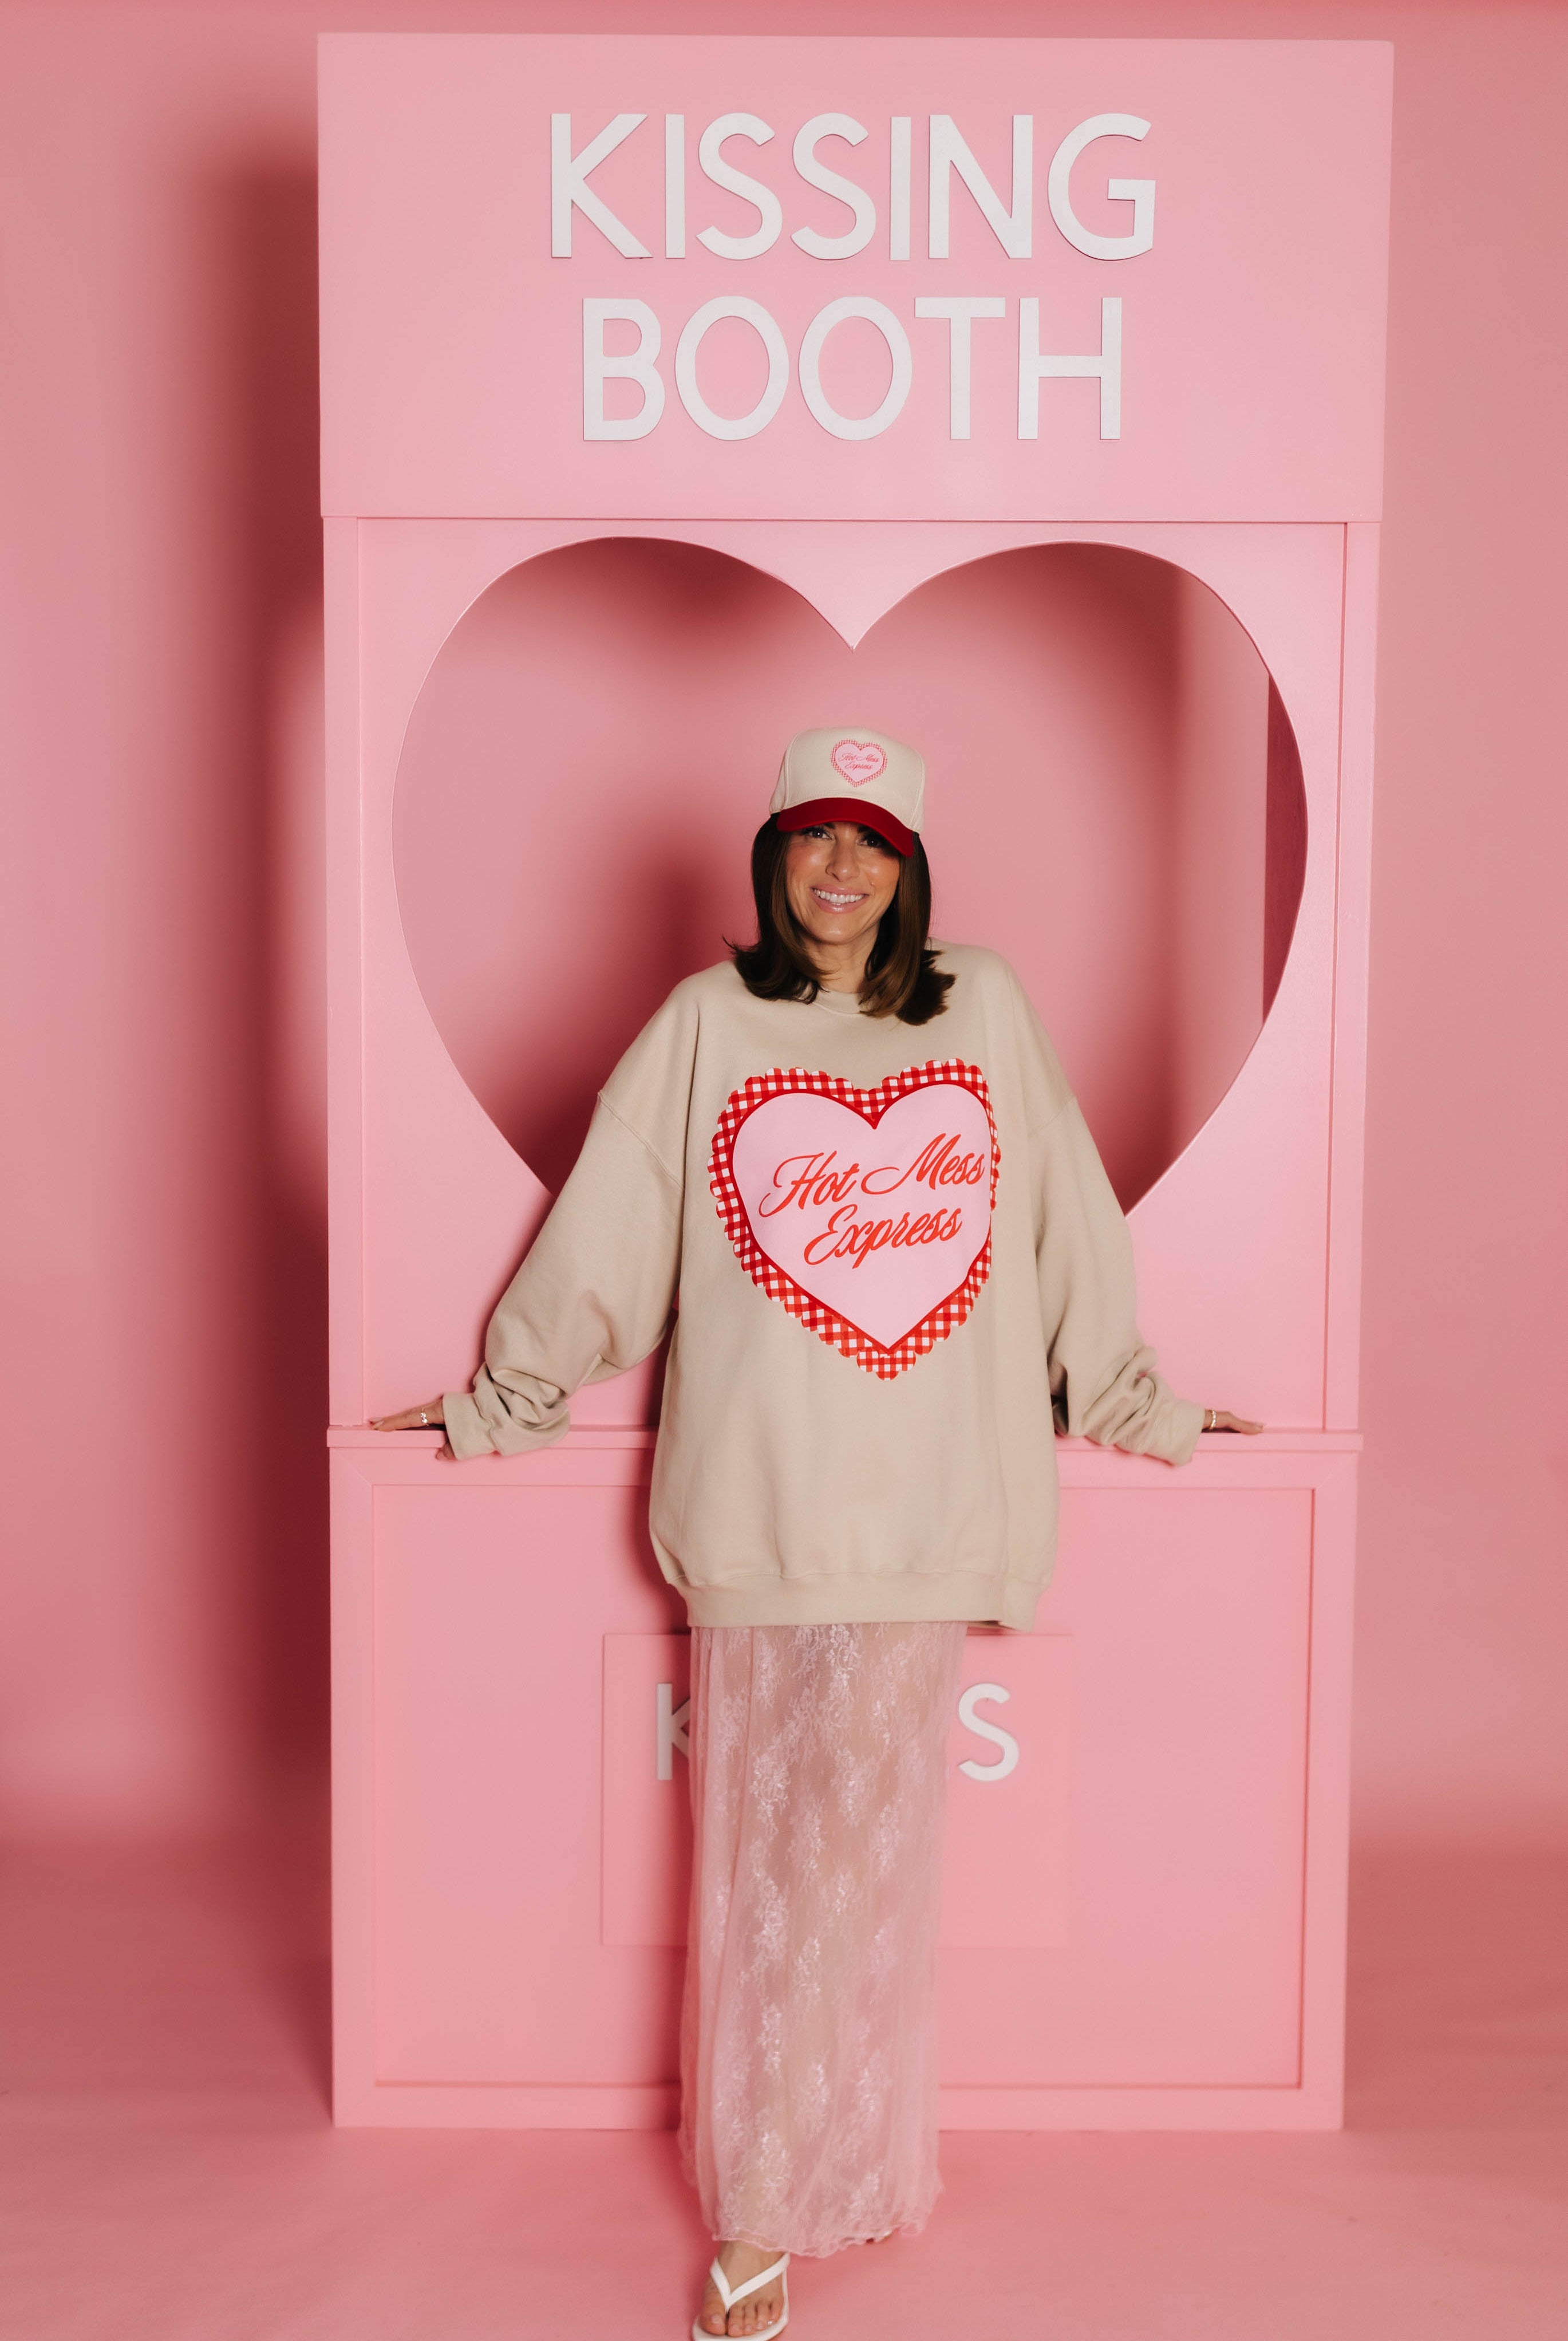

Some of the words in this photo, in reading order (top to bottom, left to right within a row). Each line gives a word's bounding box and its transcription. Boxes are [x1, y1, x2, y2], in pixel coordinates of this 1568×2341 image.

[551, 113, 1155, 261] KISSING
[583, 296, 1121, 441] BOOTH
[839, 752, 856, 762] Hot
[856, 754, 879, 763] Mess
[844, 762, 873, 770] Express
[759, 1150, 859, 1217] Hot
[861, 1133, 985, 1195] Mess
[804, 1204, 962, 1268] Express
